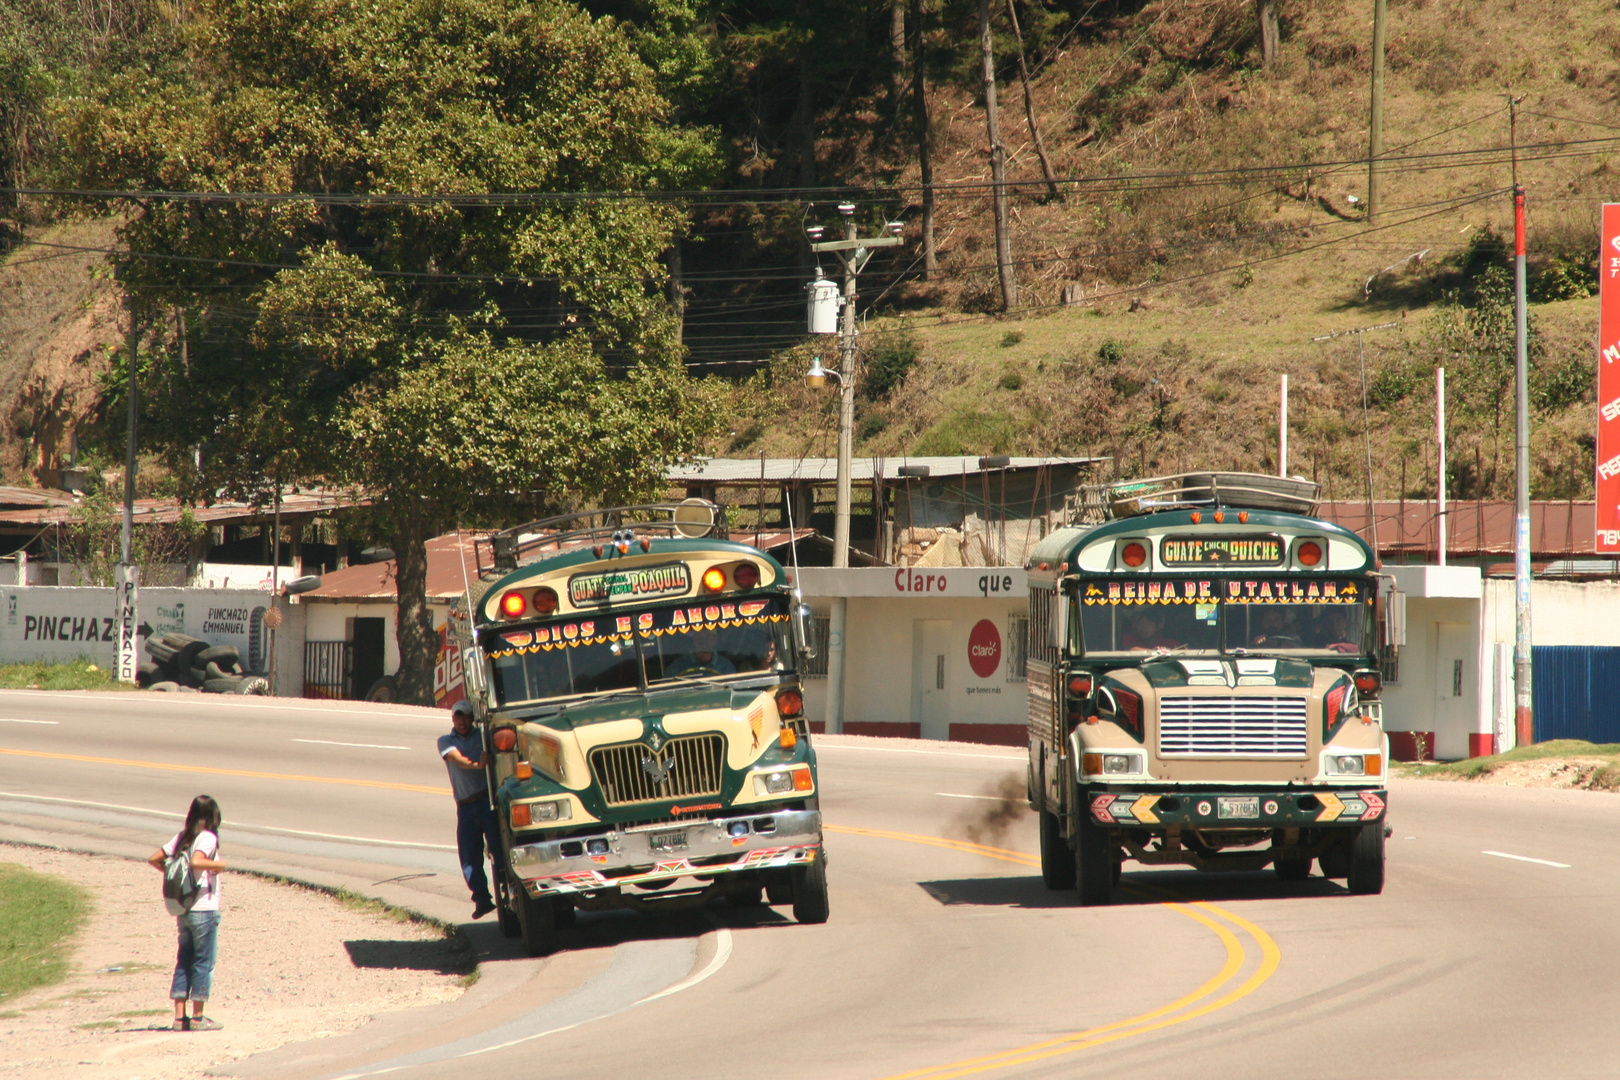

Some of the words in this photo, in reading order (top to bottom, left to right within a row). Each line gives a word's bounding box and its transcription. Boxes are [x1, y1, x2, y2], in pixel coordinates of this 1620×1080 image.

[1602, 340, 1620, 364] M
[1165, 541, 1203, 561] GUATE
[1204, 541, 1229, 552] CHICHI
[1230, 541, 1279, 561] QUICHE
[572, 576, 608, 601] GUATE
[629, 566, 686, 594] POAQUIL
[895, 568, 947, 592] Claro
[979, 575, 1012, 598] que
[1109, 581, 1176, 598] REINA
[1185, 581, 1211, 597] DE
[1229, 581, 1337, 597] UTATLAN
[208, 607, 249, 621] PINCHAZO
[535, 621, 595, 644] DIOS
[616, 612, 654, 633] ES
[672, 603, 737, 626] AMOR
[24, 615, 114, 642] PINCHAZ
[202, 621, 245, 634] EMMANUEL
[972, 644, 995, 657] Claro
